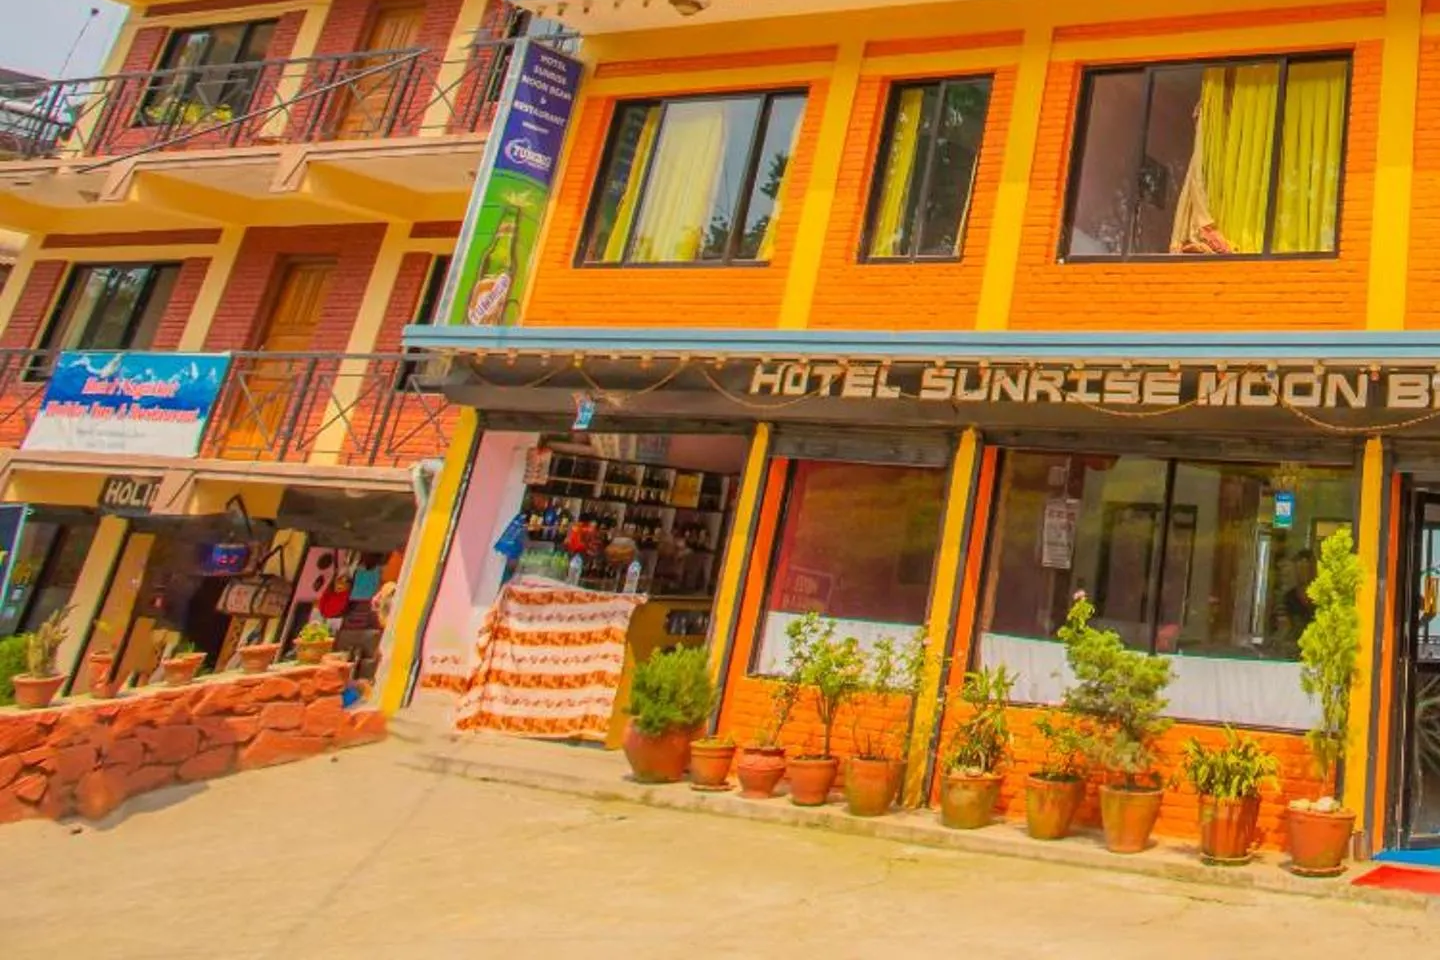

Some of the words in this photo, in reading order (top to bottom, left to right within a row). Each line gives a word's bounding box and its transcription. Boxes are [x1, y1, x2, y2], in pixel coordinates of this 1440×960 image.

[540, 54, 567, 73] HOTEL
[749, 363, 901, 398] HOTEL
[919, 367, 1182, 405] SUNRISE
[1198, 370, 1369, 408] MOON
